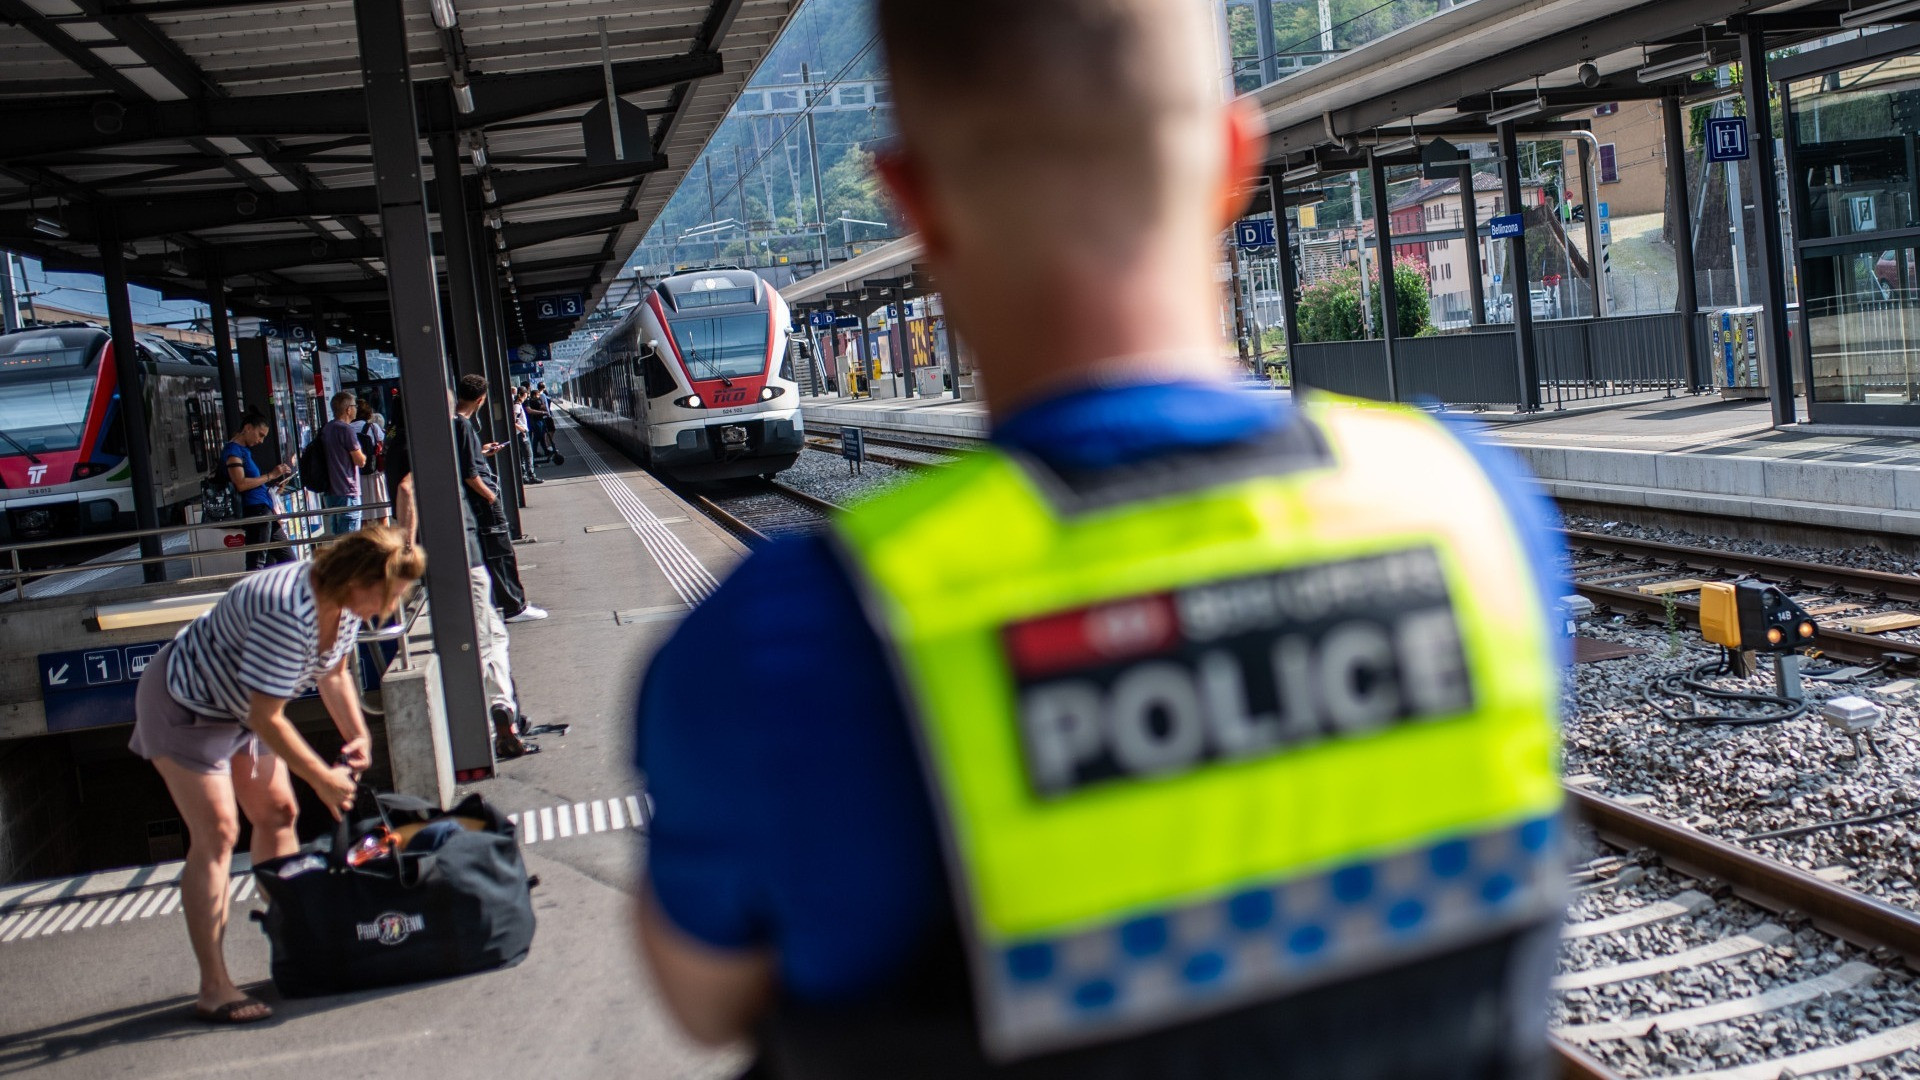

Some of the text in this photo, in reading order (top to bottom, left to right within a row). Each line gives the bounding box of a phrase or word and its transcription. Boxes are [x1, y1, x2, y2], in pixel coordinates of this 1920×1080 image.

[1245, 229, 1257, 242] D
[1491, 223, 1519, 236] Bellinzona
[541, 301, 576, 315] G 3
[826, 315, 832, 323] D
[292, 326, 304, 339] G
[1777, 610, 1792, 622] 14B
[97, 660, 108, 679] 1
[1025, 606, 1471, 798] POLICE
